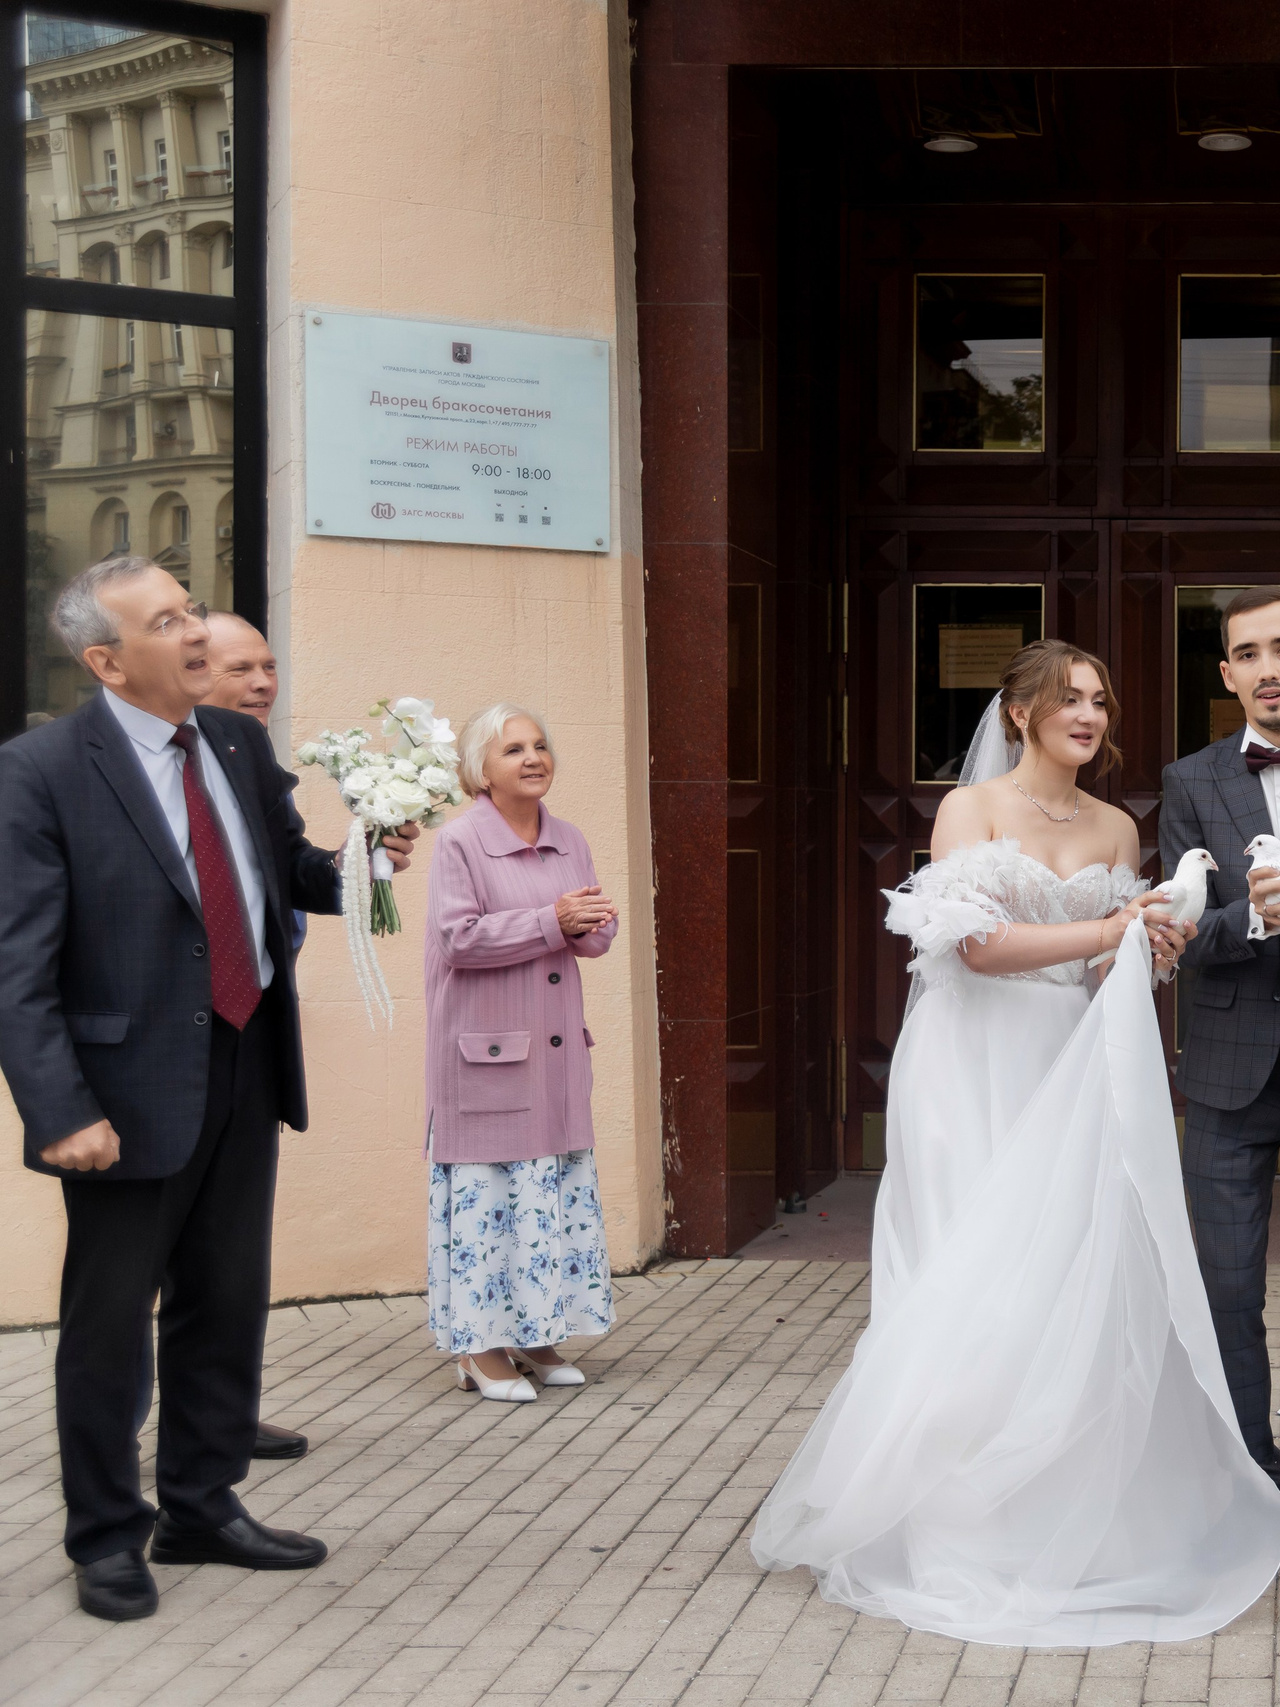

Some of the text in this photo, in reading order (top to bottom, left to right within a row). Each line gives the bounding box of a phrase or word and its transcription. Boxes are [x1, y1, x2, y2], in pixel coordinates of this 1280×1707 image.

[382, 365, 418, 374] УПРАВЛЕНИЕ
[418, 368, 443, 377] ЗАПИСИ
[462, 373, 506, 382] ГРАЖДАНСКОГО
[506, 377, 540, 385] СОСТОЯНИЯ
[461, 381, 486, 389] МОСКВЫ
[369, 390, 552, 420] Дворец бракосочетания
[406, 437, 518, 457] РЕЖИМ РАБОТЫ
[370, 459, 398, 467] ВТОРНИК
[402, 461, 430, 469] СУББОТА
[471, 463, 502, 478] 9:00
[516, 467, 552, 481] 18:00
[370, 479, 412, 488] ВОСКРЕСЕНЬЕ
[416, 482, 461, 491] ПОНЕДЕЛЬНИК
[493, 488, 528, 497] ВЫХОДНОЙ
[401, 508, 464, 520] ЗАГС МОСКВЫ
